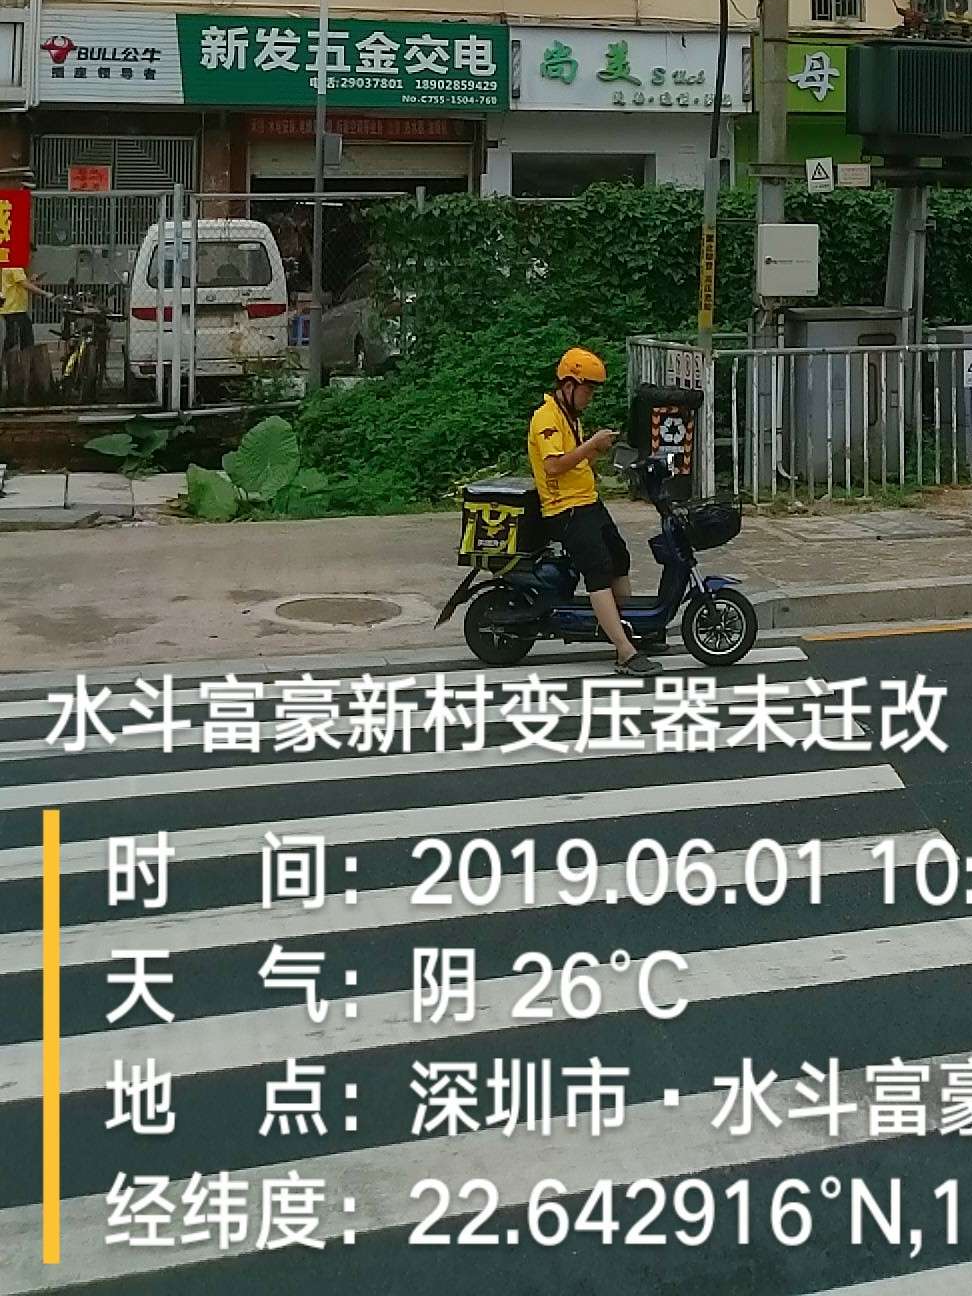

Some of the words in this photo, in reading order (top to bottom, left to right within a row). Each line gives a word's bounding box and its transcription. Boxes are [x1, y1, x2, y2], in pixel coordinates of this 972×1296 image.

[77, 46, 162, 63] BULL公牛
[200, 25, 497, 76] 新发五金交电
[540, 39, 643, 87] 尚美
[788, 51, 841, 102] 母
